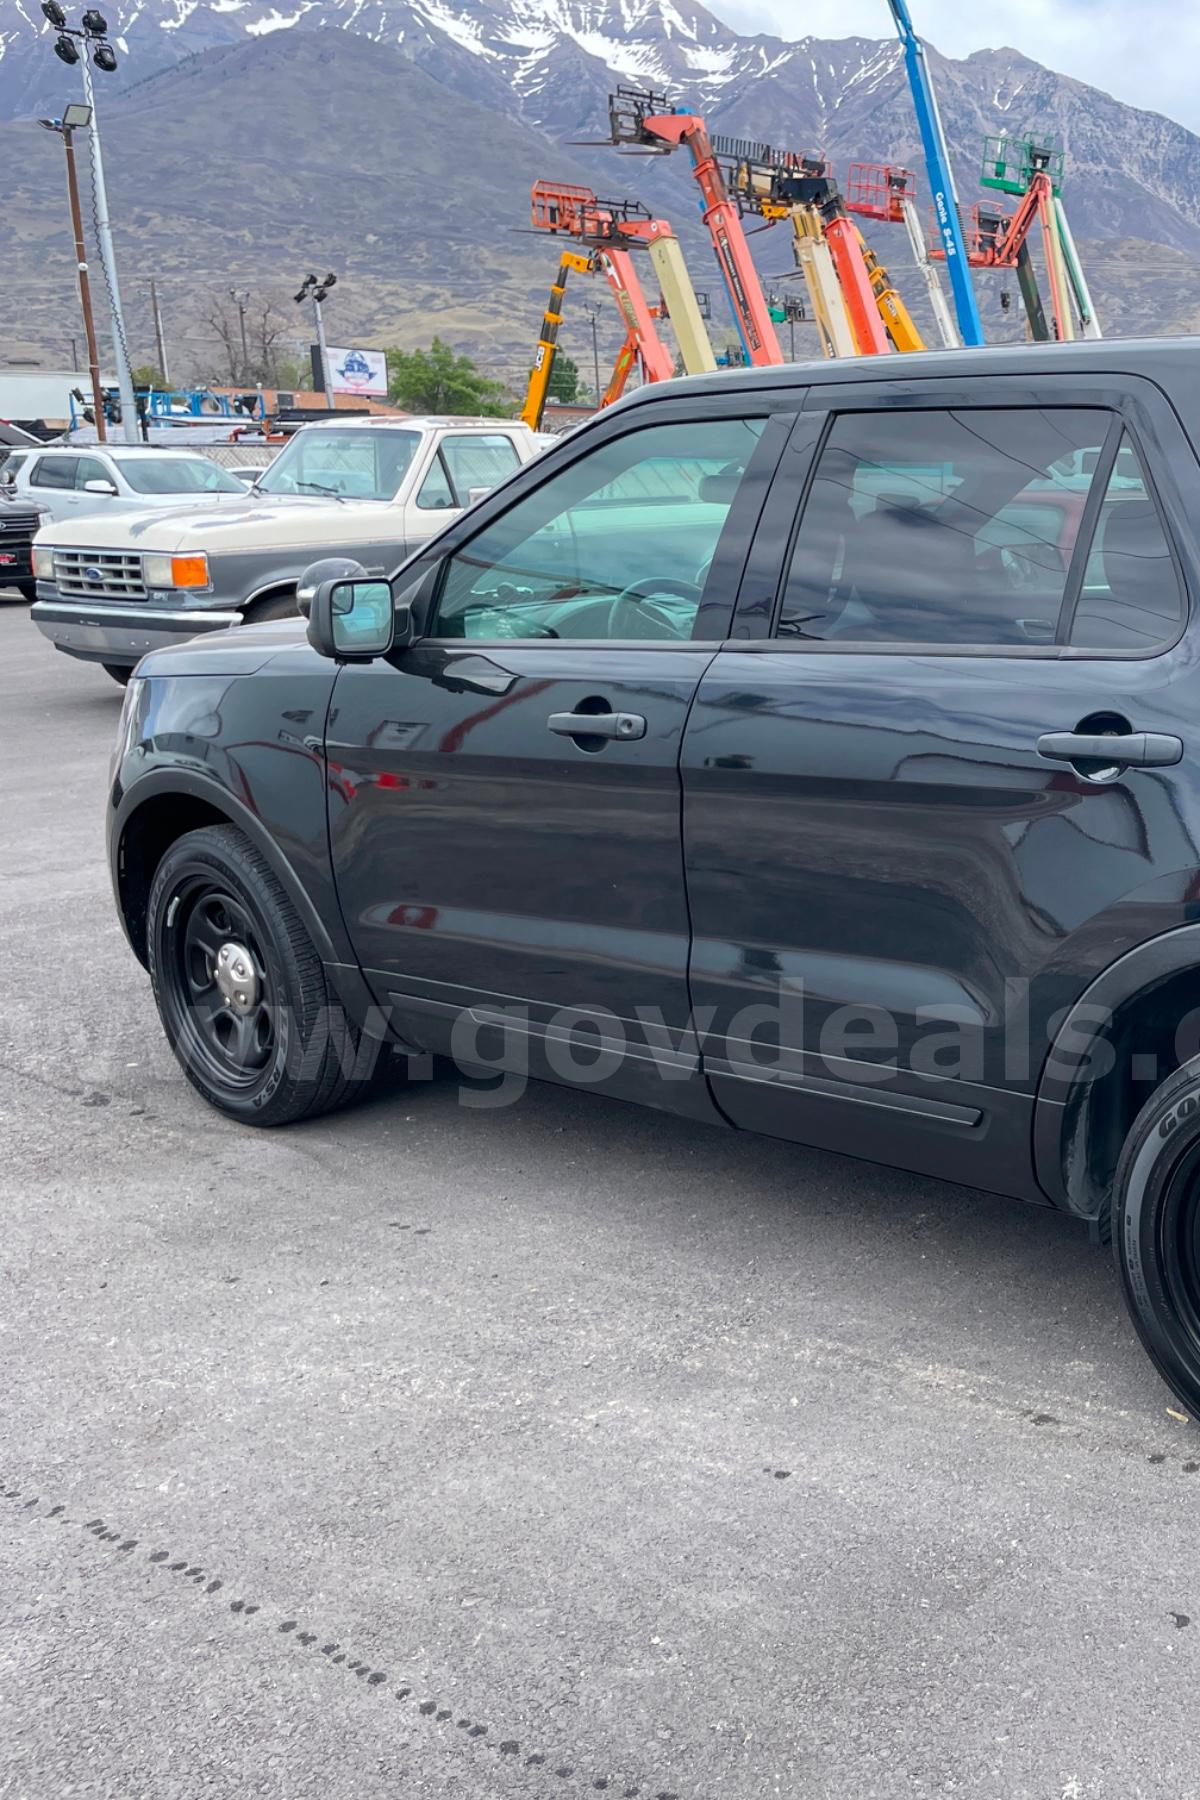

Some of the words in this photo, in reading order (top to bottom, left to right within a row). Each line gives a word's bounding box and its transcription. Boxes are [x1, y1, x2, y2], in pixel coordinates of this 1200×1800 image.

[935, 191, 948, 224] Genie
[943, 228, 957, 256] S-45
[535, 346, 546, 372] JCB
